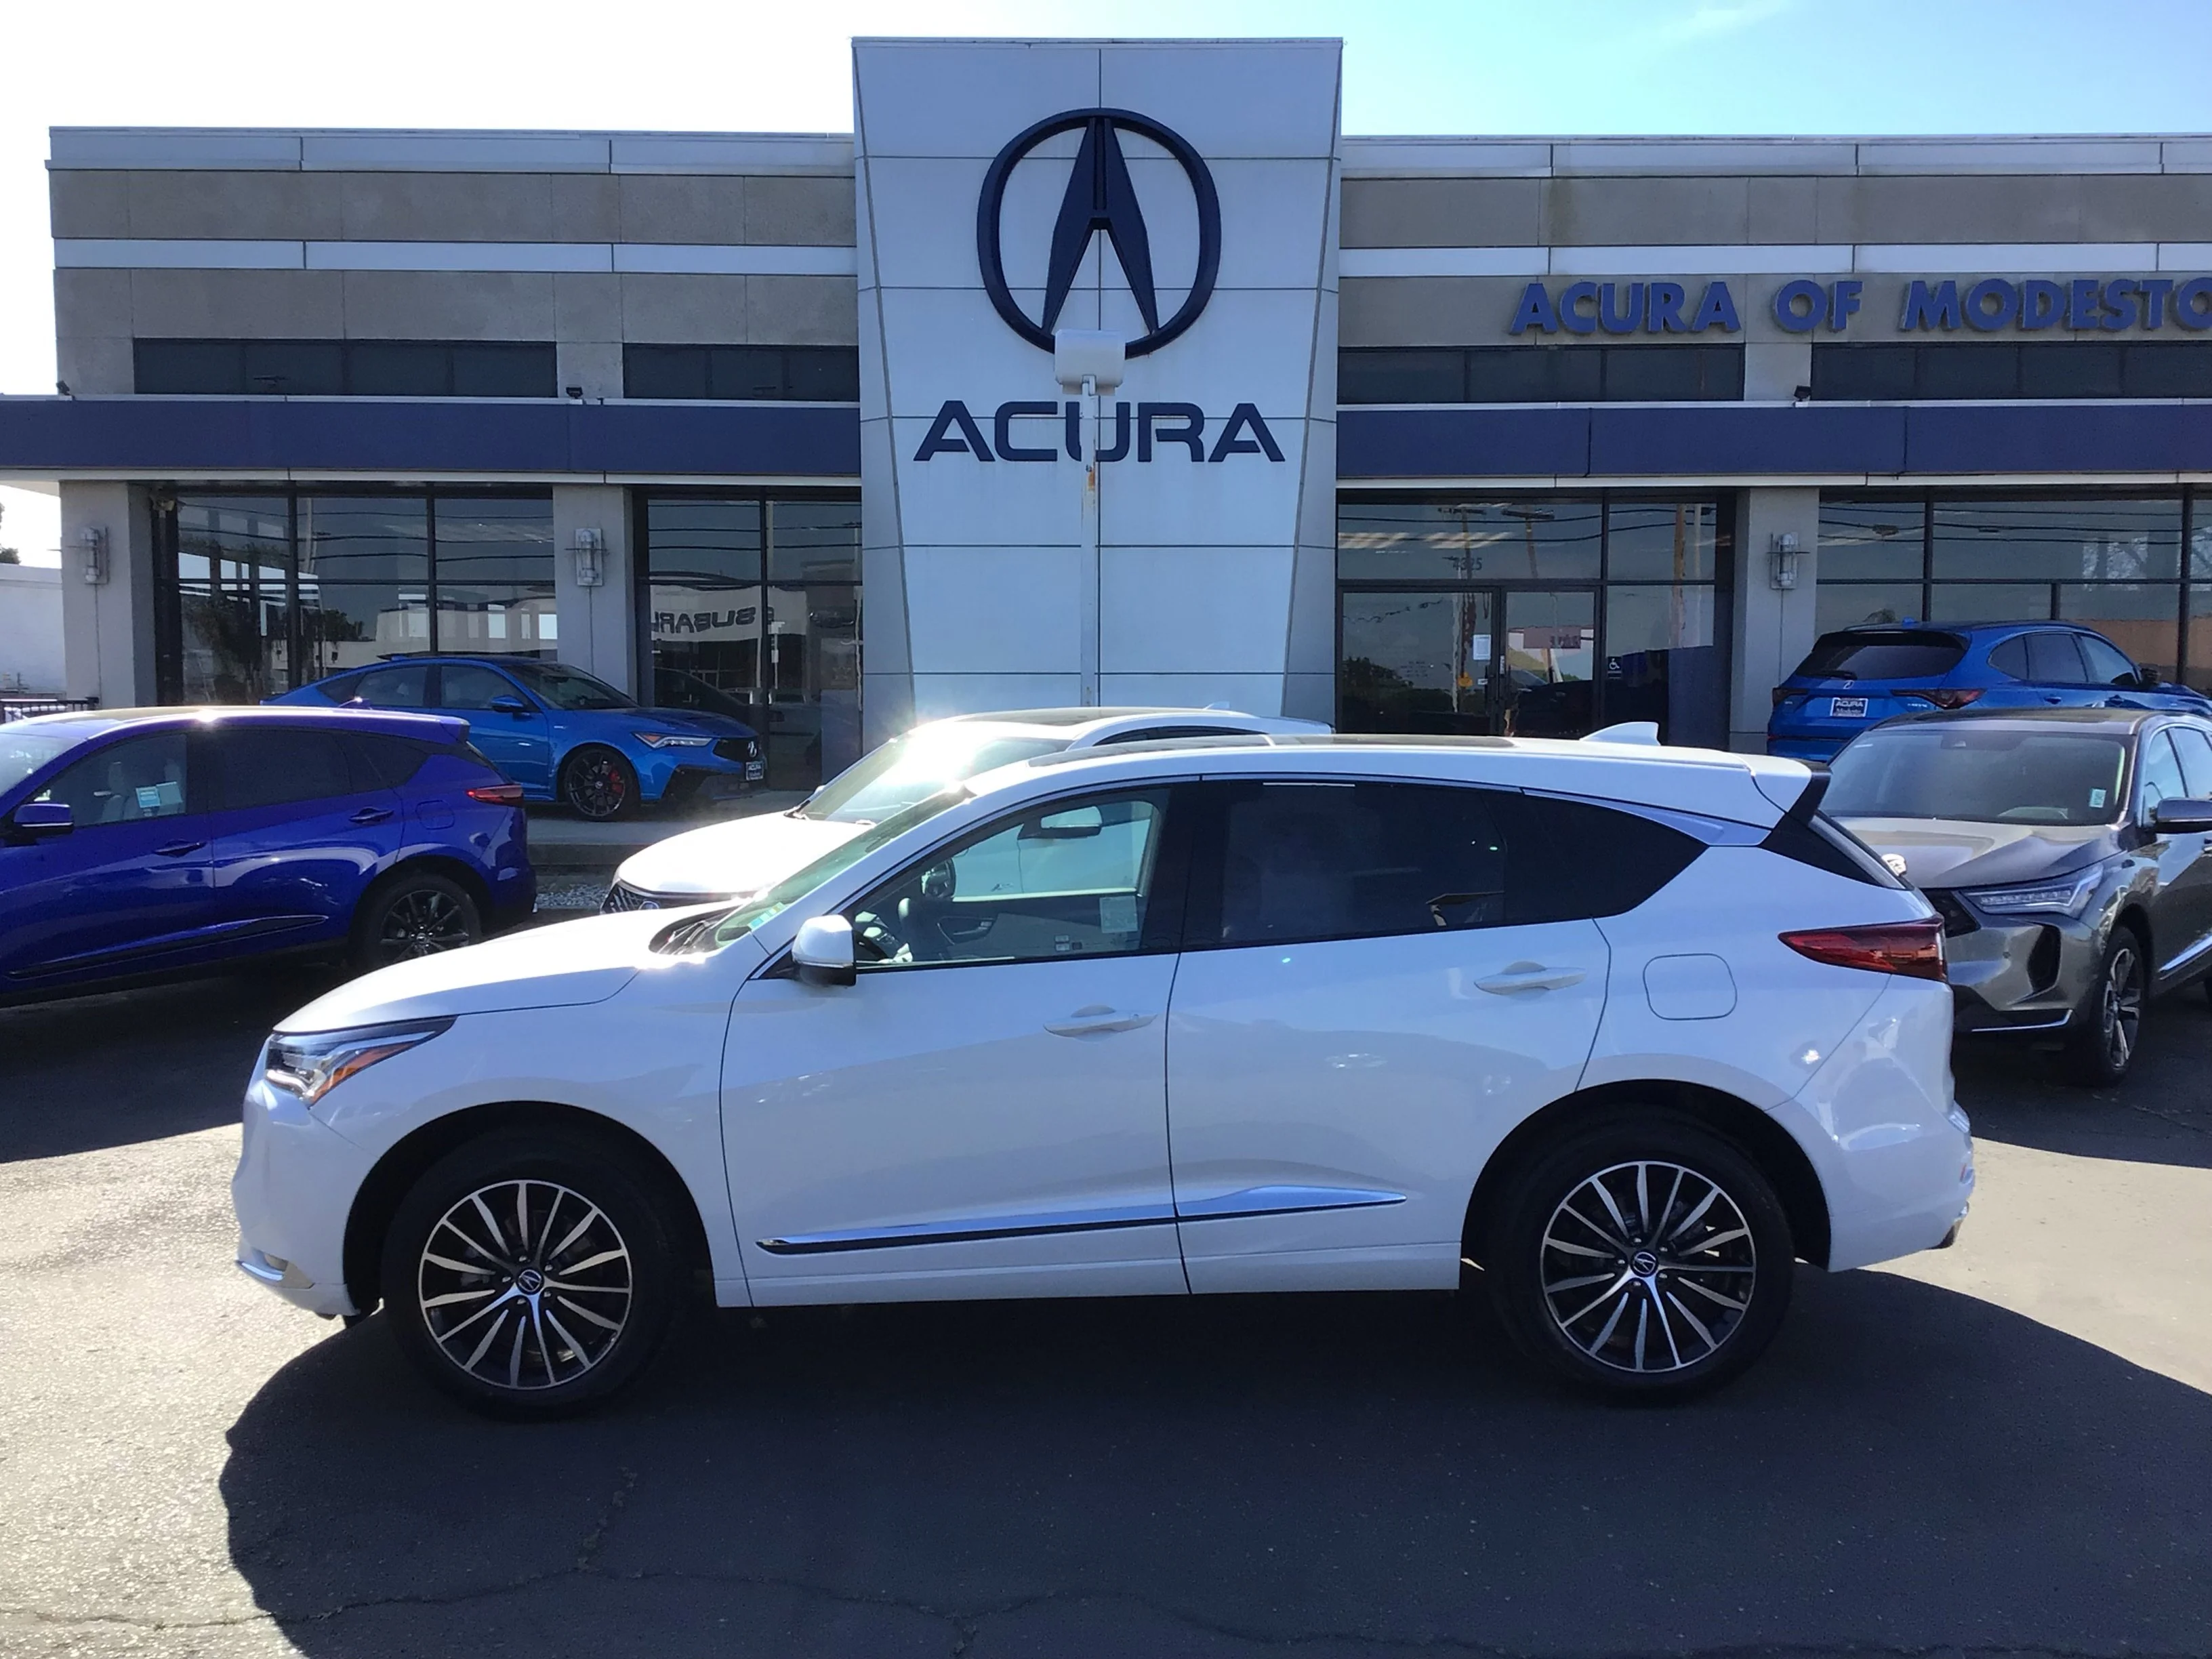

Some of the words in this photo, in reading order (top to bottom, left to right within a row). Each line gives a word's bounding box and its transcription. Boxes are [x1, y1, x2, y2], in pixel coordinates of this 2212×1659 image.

[1509, 281, 1742, 335] ACURA
[1773, 279, 1863, 333] OF
[1900, 277, 2212, 331] MODESTO
[913, 400, 1286, 462] ACURA
